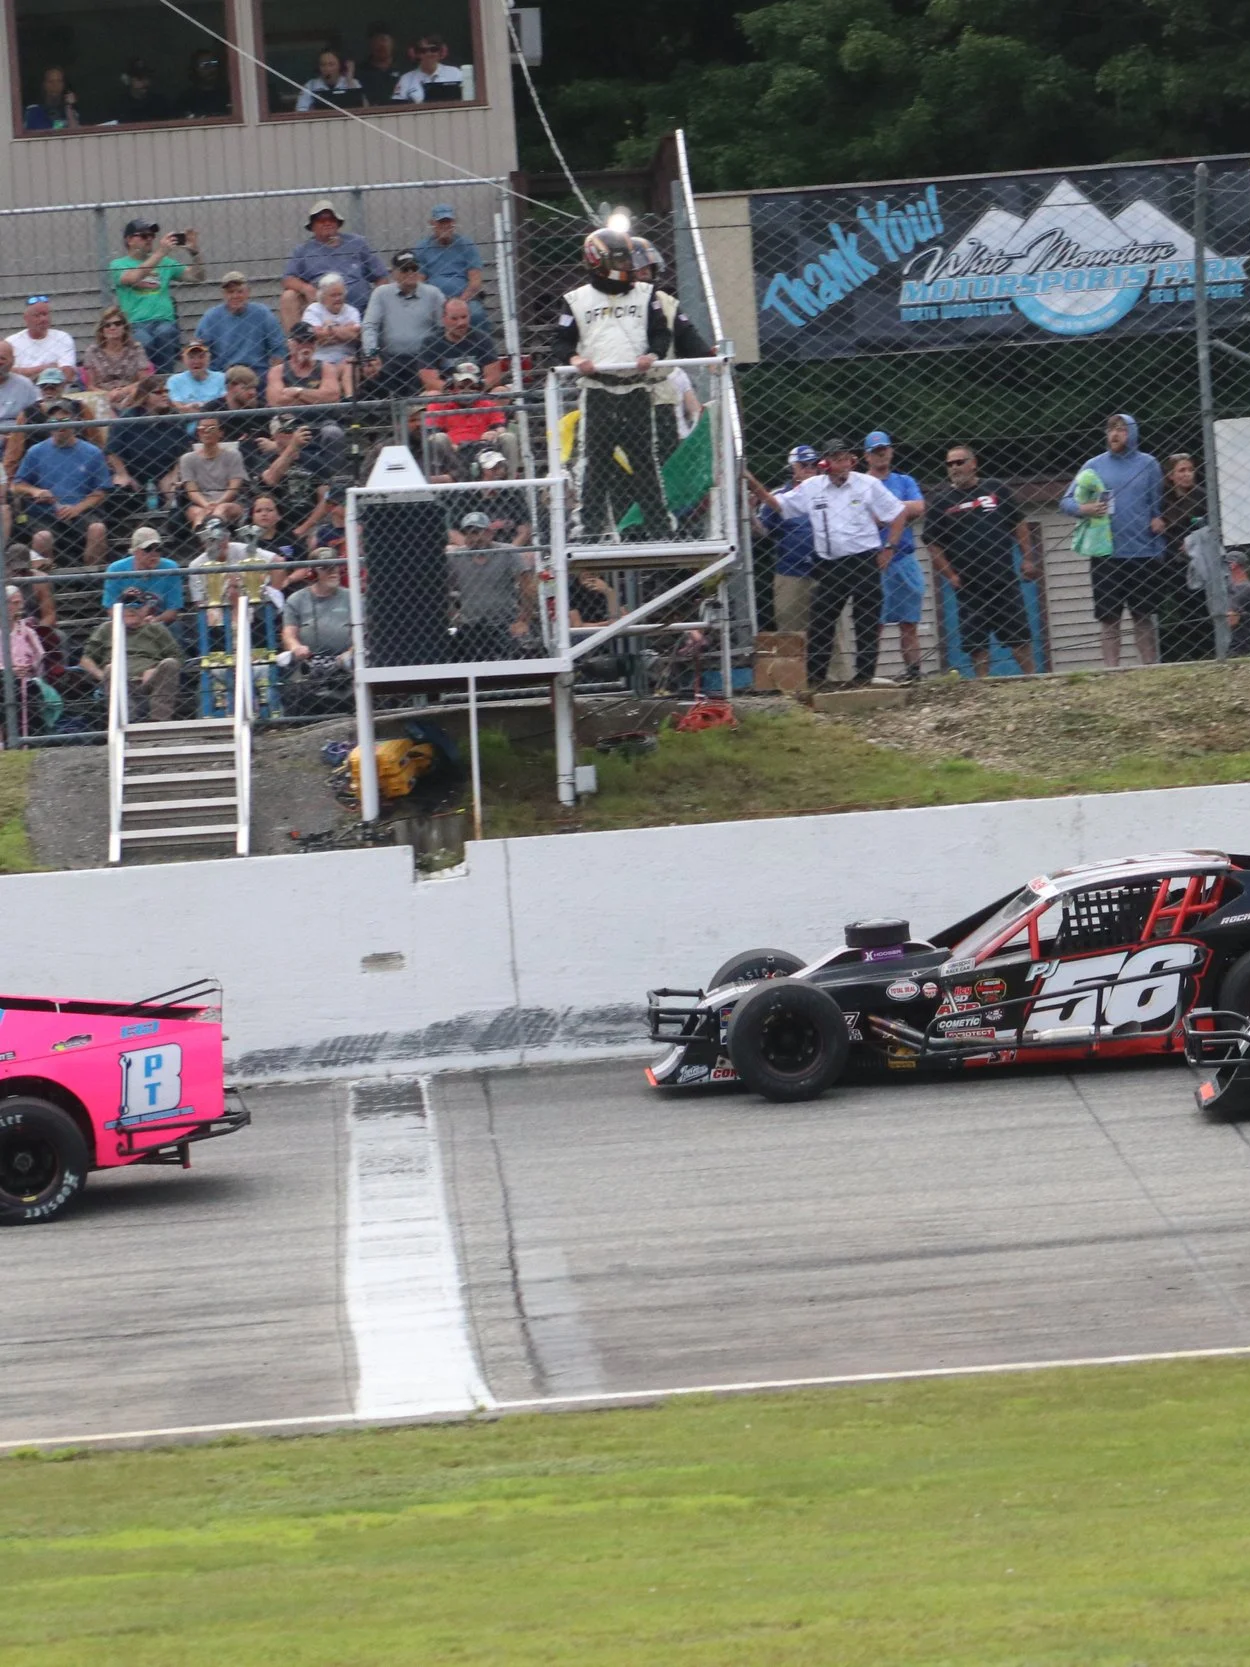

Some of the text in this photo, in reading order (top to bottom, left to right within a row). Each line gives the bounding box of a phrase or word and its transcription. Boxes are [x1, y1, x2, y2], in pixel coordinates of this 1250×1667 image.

[760, 183, 945, 328] Thank You!
[899, 255, 1250, 305] MOTORSPORTS PARK
[902, 226, 1179, 287] White Mountain
[585, 304, 643, 325] OFFICIAL
[1023, 942, 1199, 1030] 56
[1025, 959, 1061, 982] PJ
[939, 1016, 980, 1029] COMETIC
